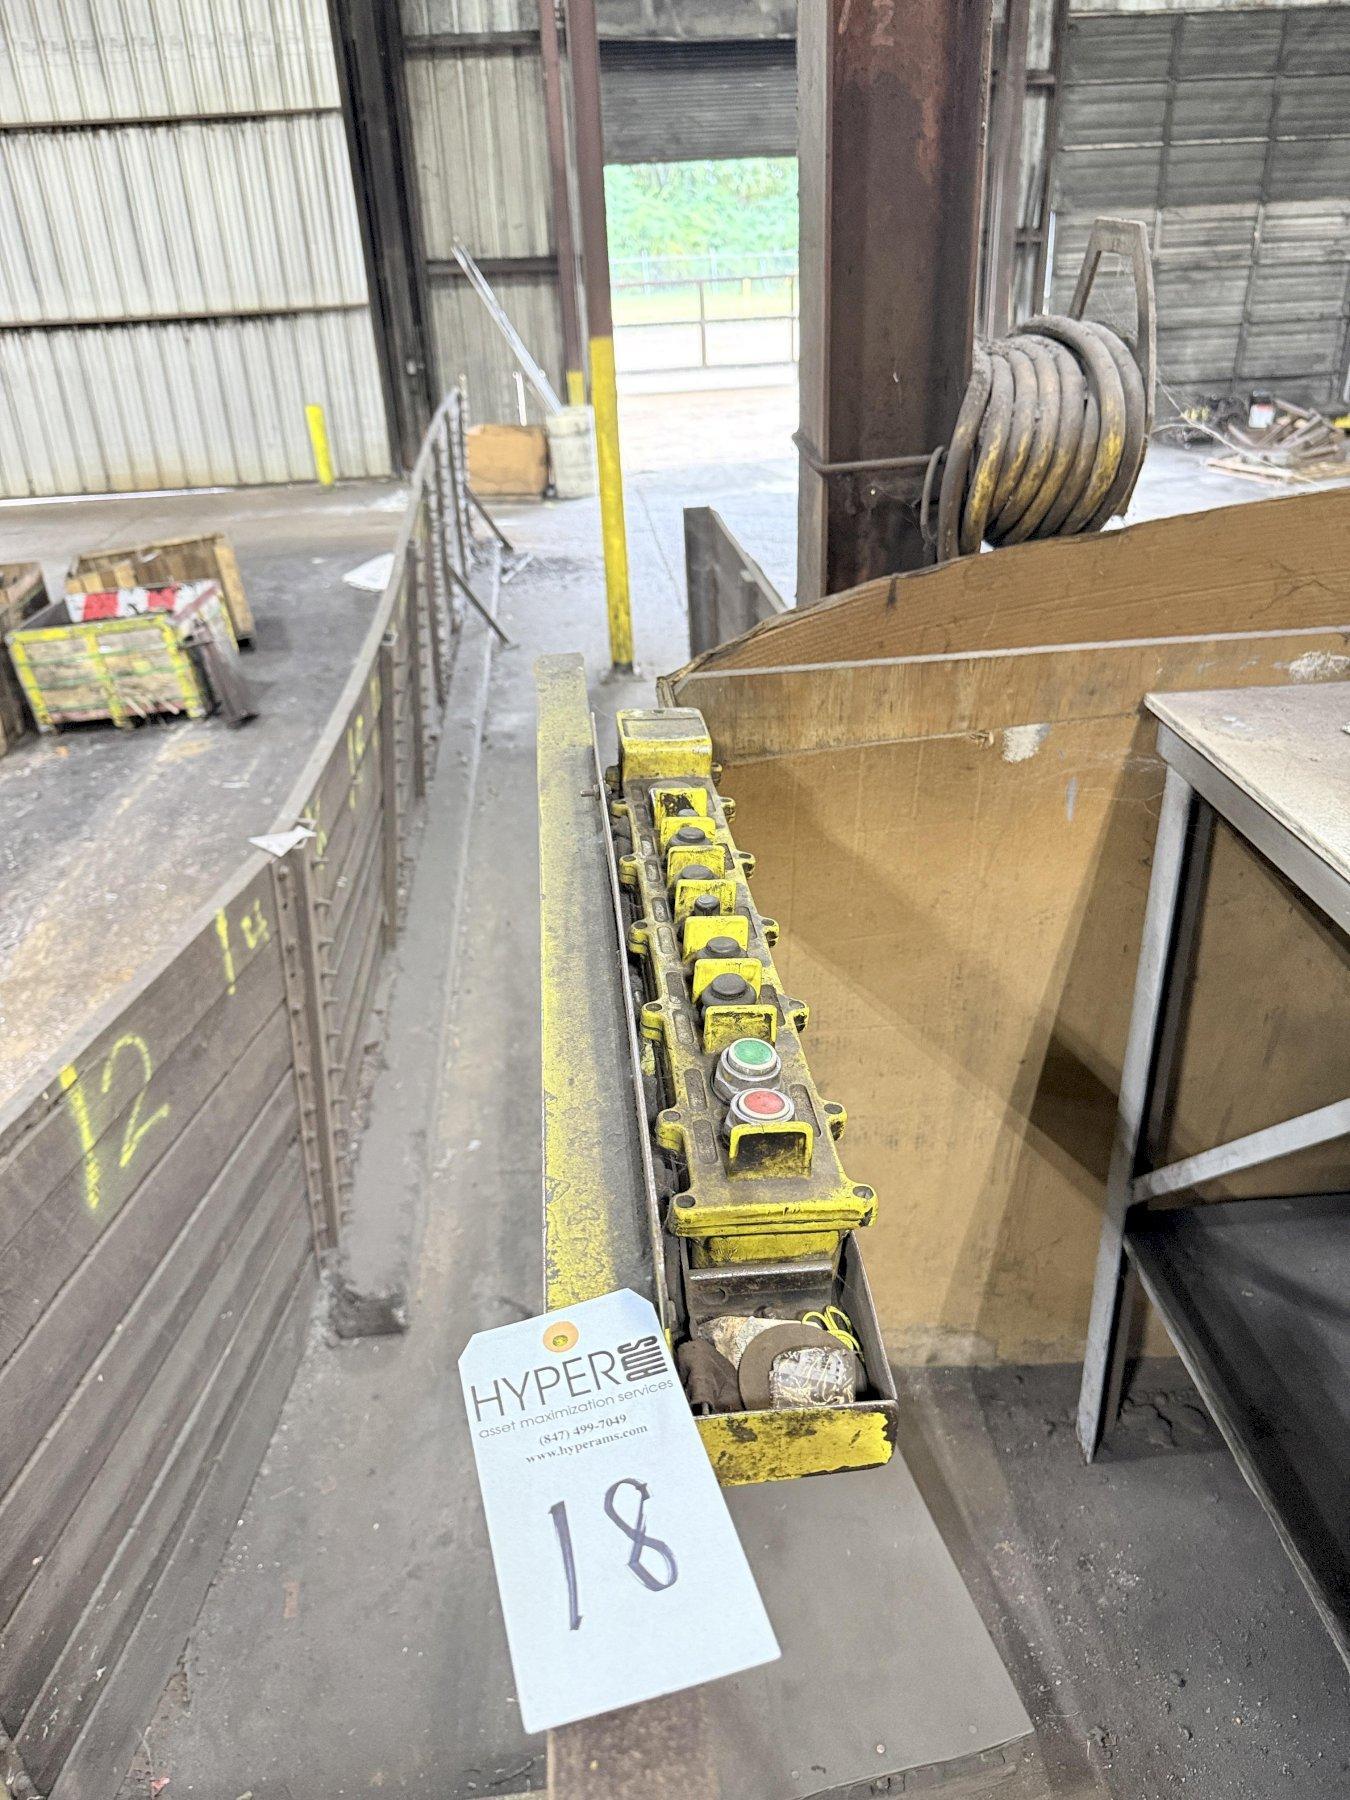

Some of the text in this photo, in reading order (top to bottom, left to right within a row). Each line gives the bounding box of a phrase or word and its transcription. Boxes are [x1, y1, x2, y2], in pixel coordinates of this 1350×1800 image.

[59, 1032, 171, 1210] 12
[470, 1349, 622, 1423] HYPER
[478, 1378, 674, 1440] asset maximization services
[525, 1423, 649, 1464] www.hyperams.com
[538, 1413, 628, 1447] (847) 499-7049
[547, 1477, 678, 1631] 18
